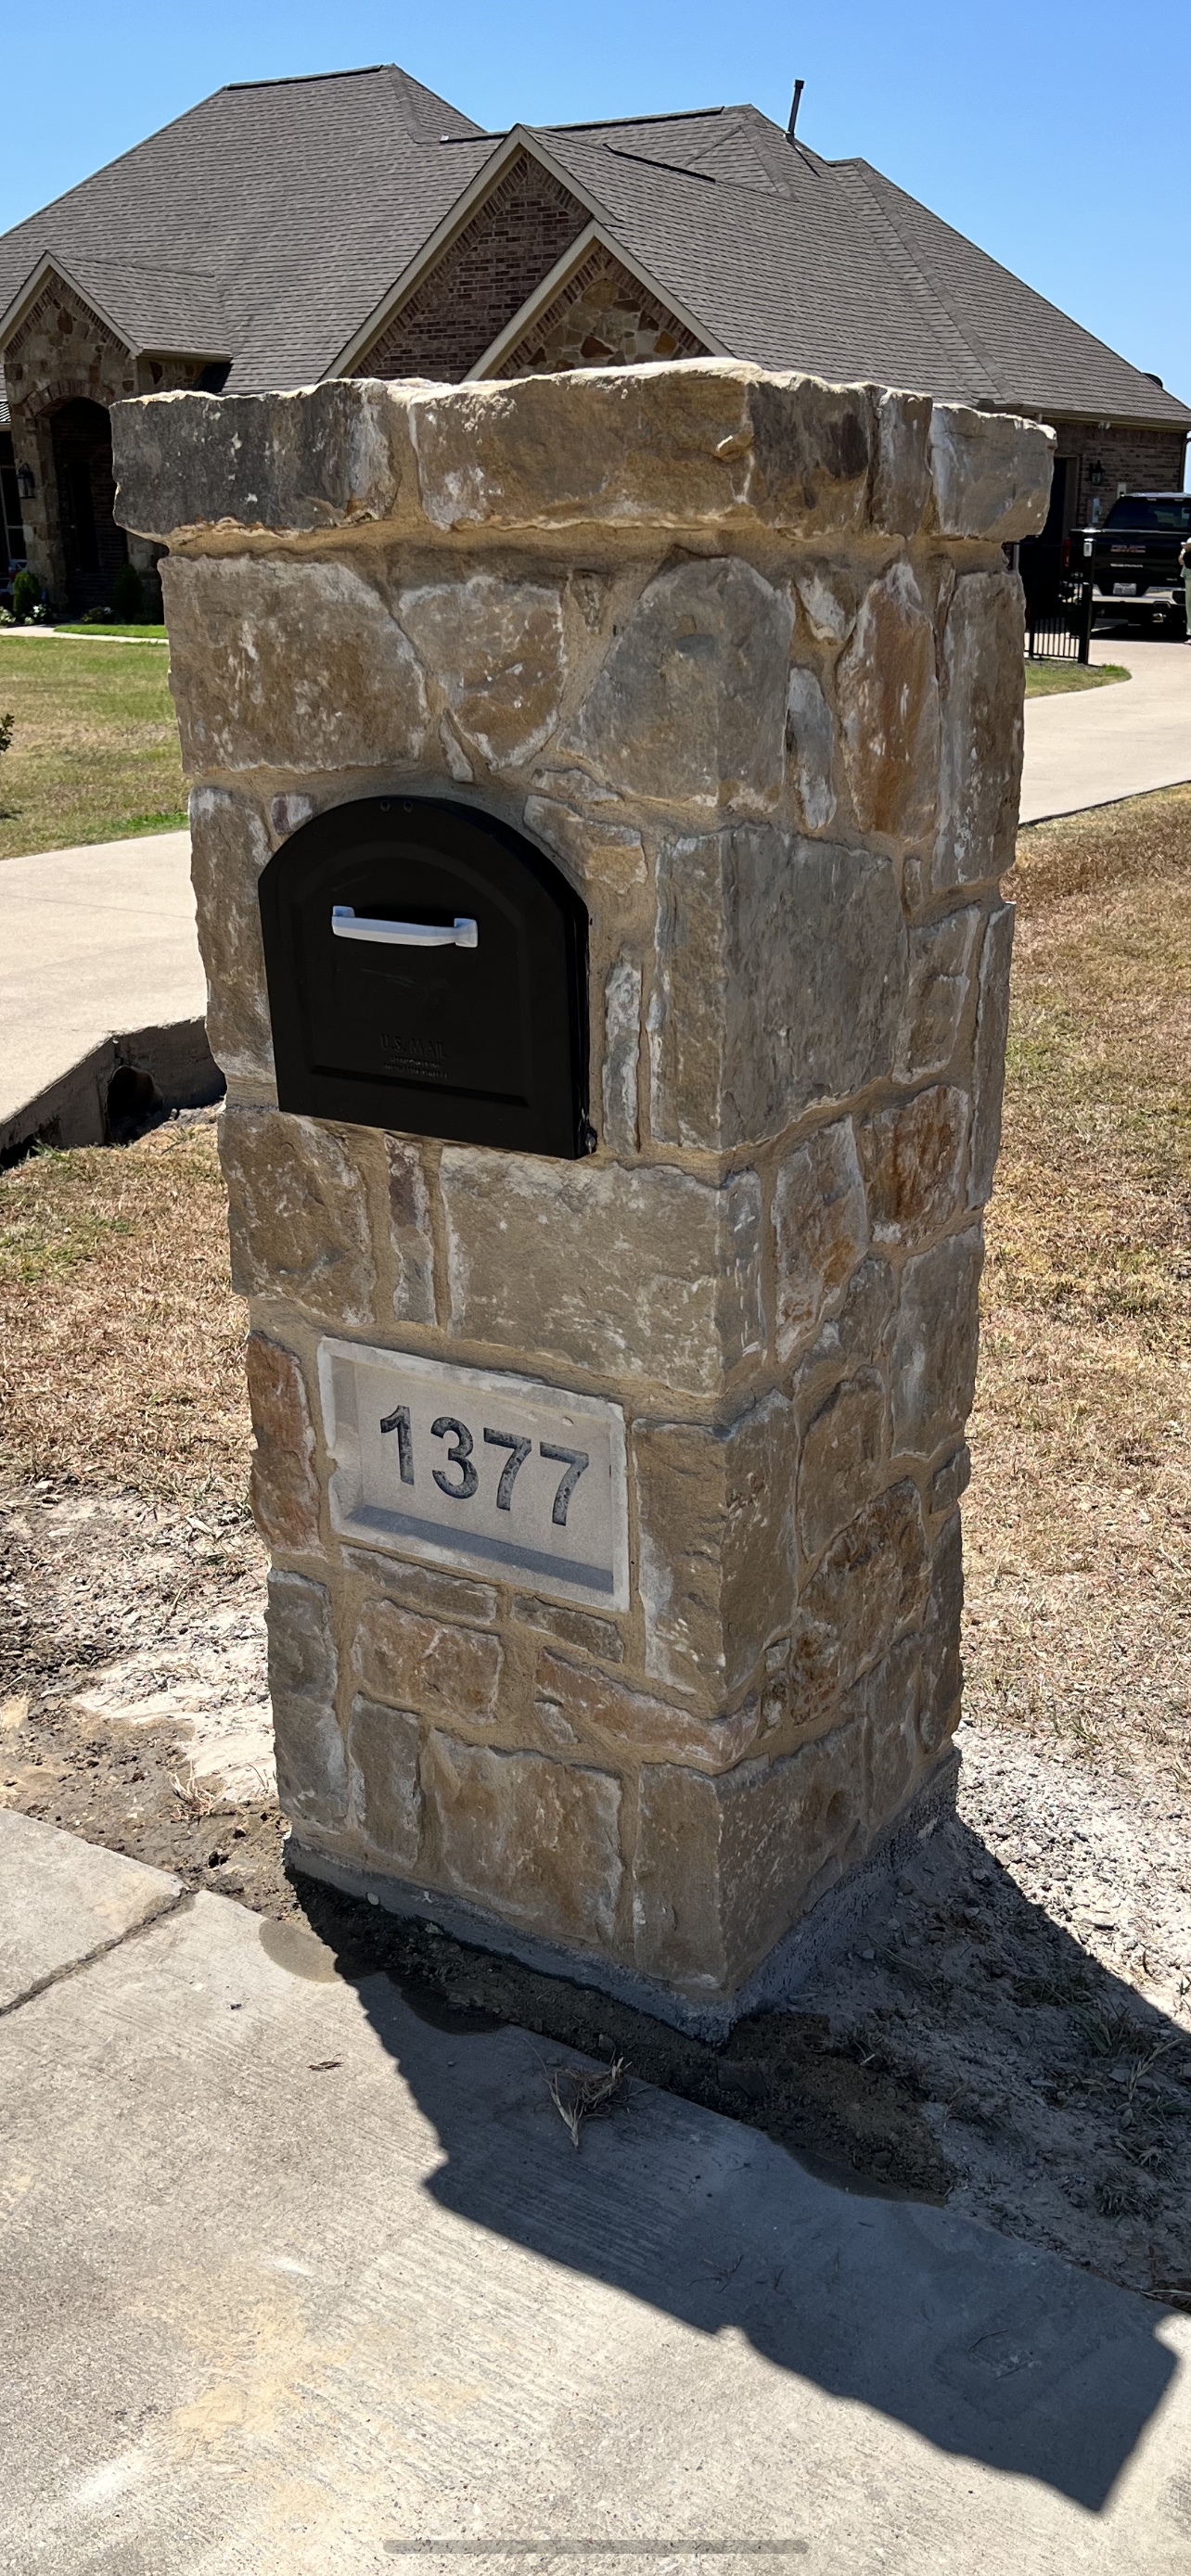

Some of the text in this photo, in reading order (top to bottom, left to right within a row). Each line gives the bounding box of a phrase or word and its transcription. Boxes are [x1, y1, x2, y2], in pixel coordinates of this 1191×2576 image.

[380, 1033, 448, 1059] U.S. MAIL
[379, 1404, 590, 1526] 1377
